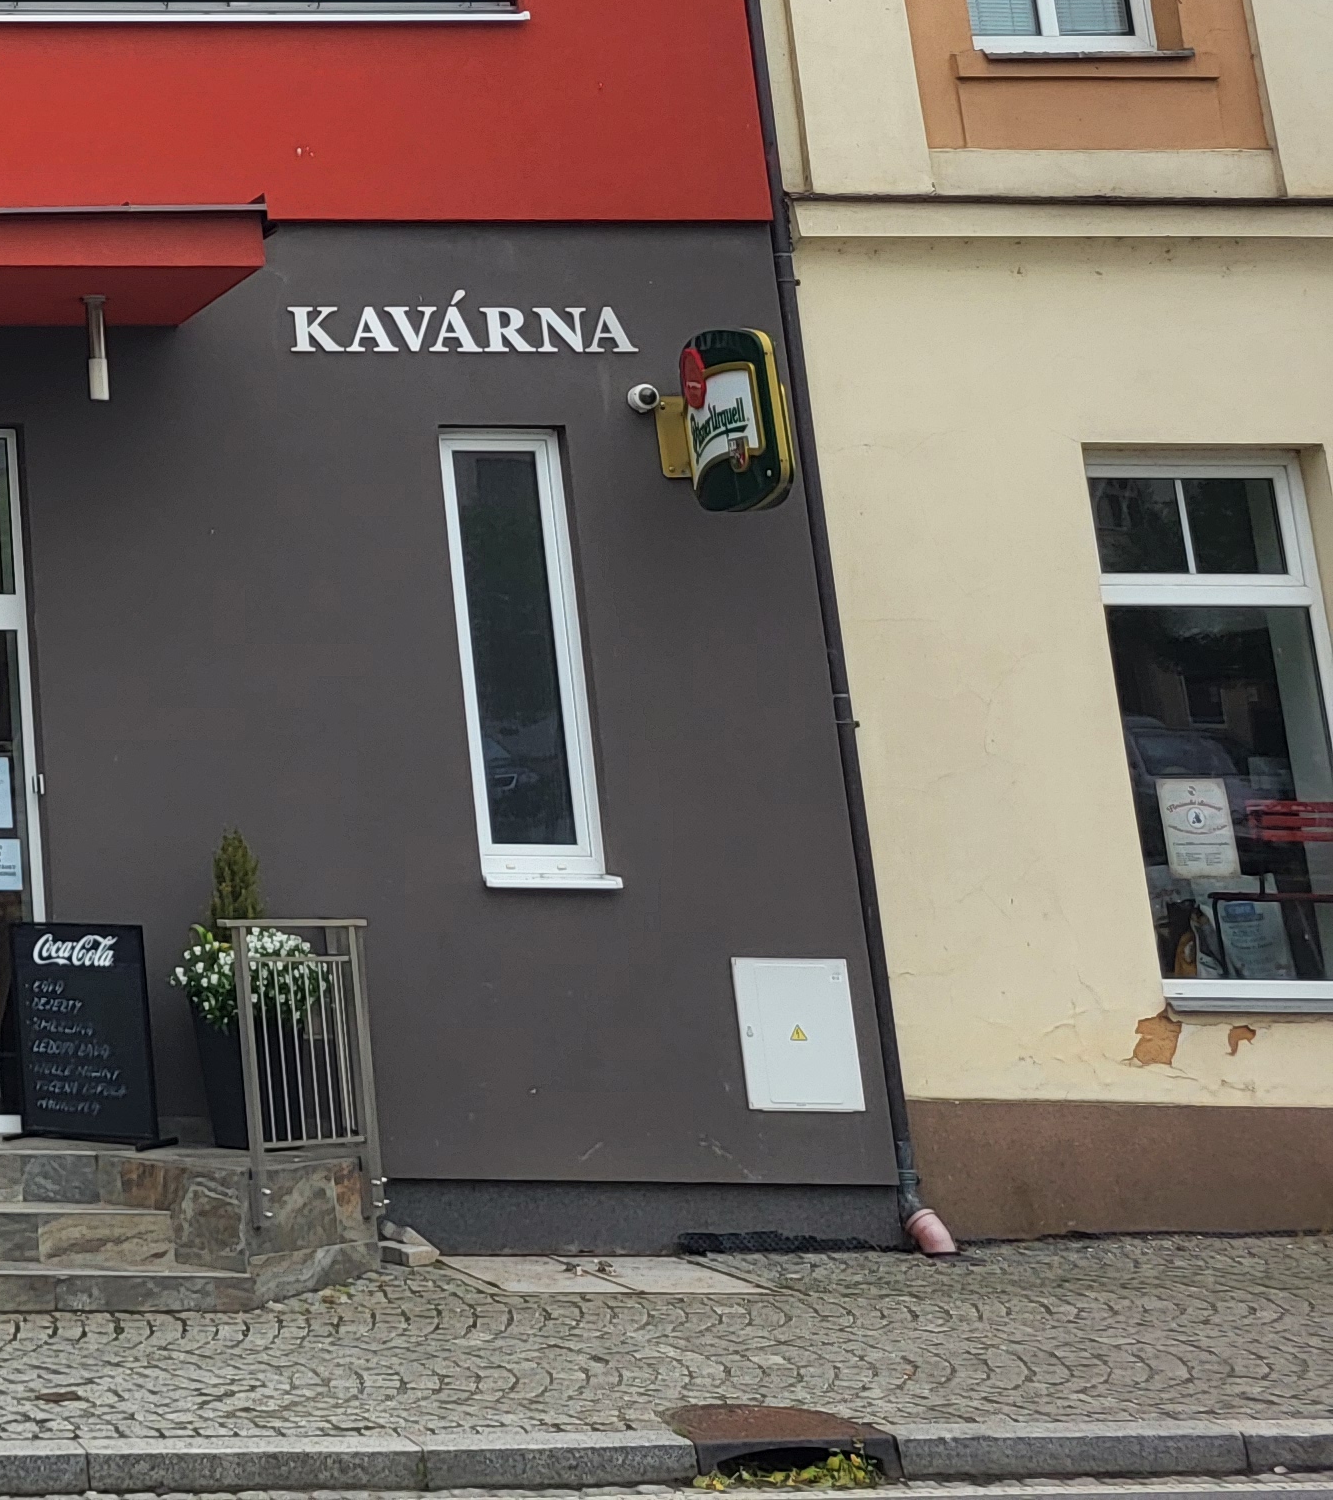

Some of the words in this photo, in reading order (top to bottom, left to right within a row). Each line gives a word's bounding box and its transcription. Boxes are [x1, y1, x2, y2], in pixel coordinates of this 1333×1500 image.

[286, 289, 639, 353] KAVÁRNA
[708, 396, 746, 438] Urquell
[33, 933, 118, 967] Coca-Cola
